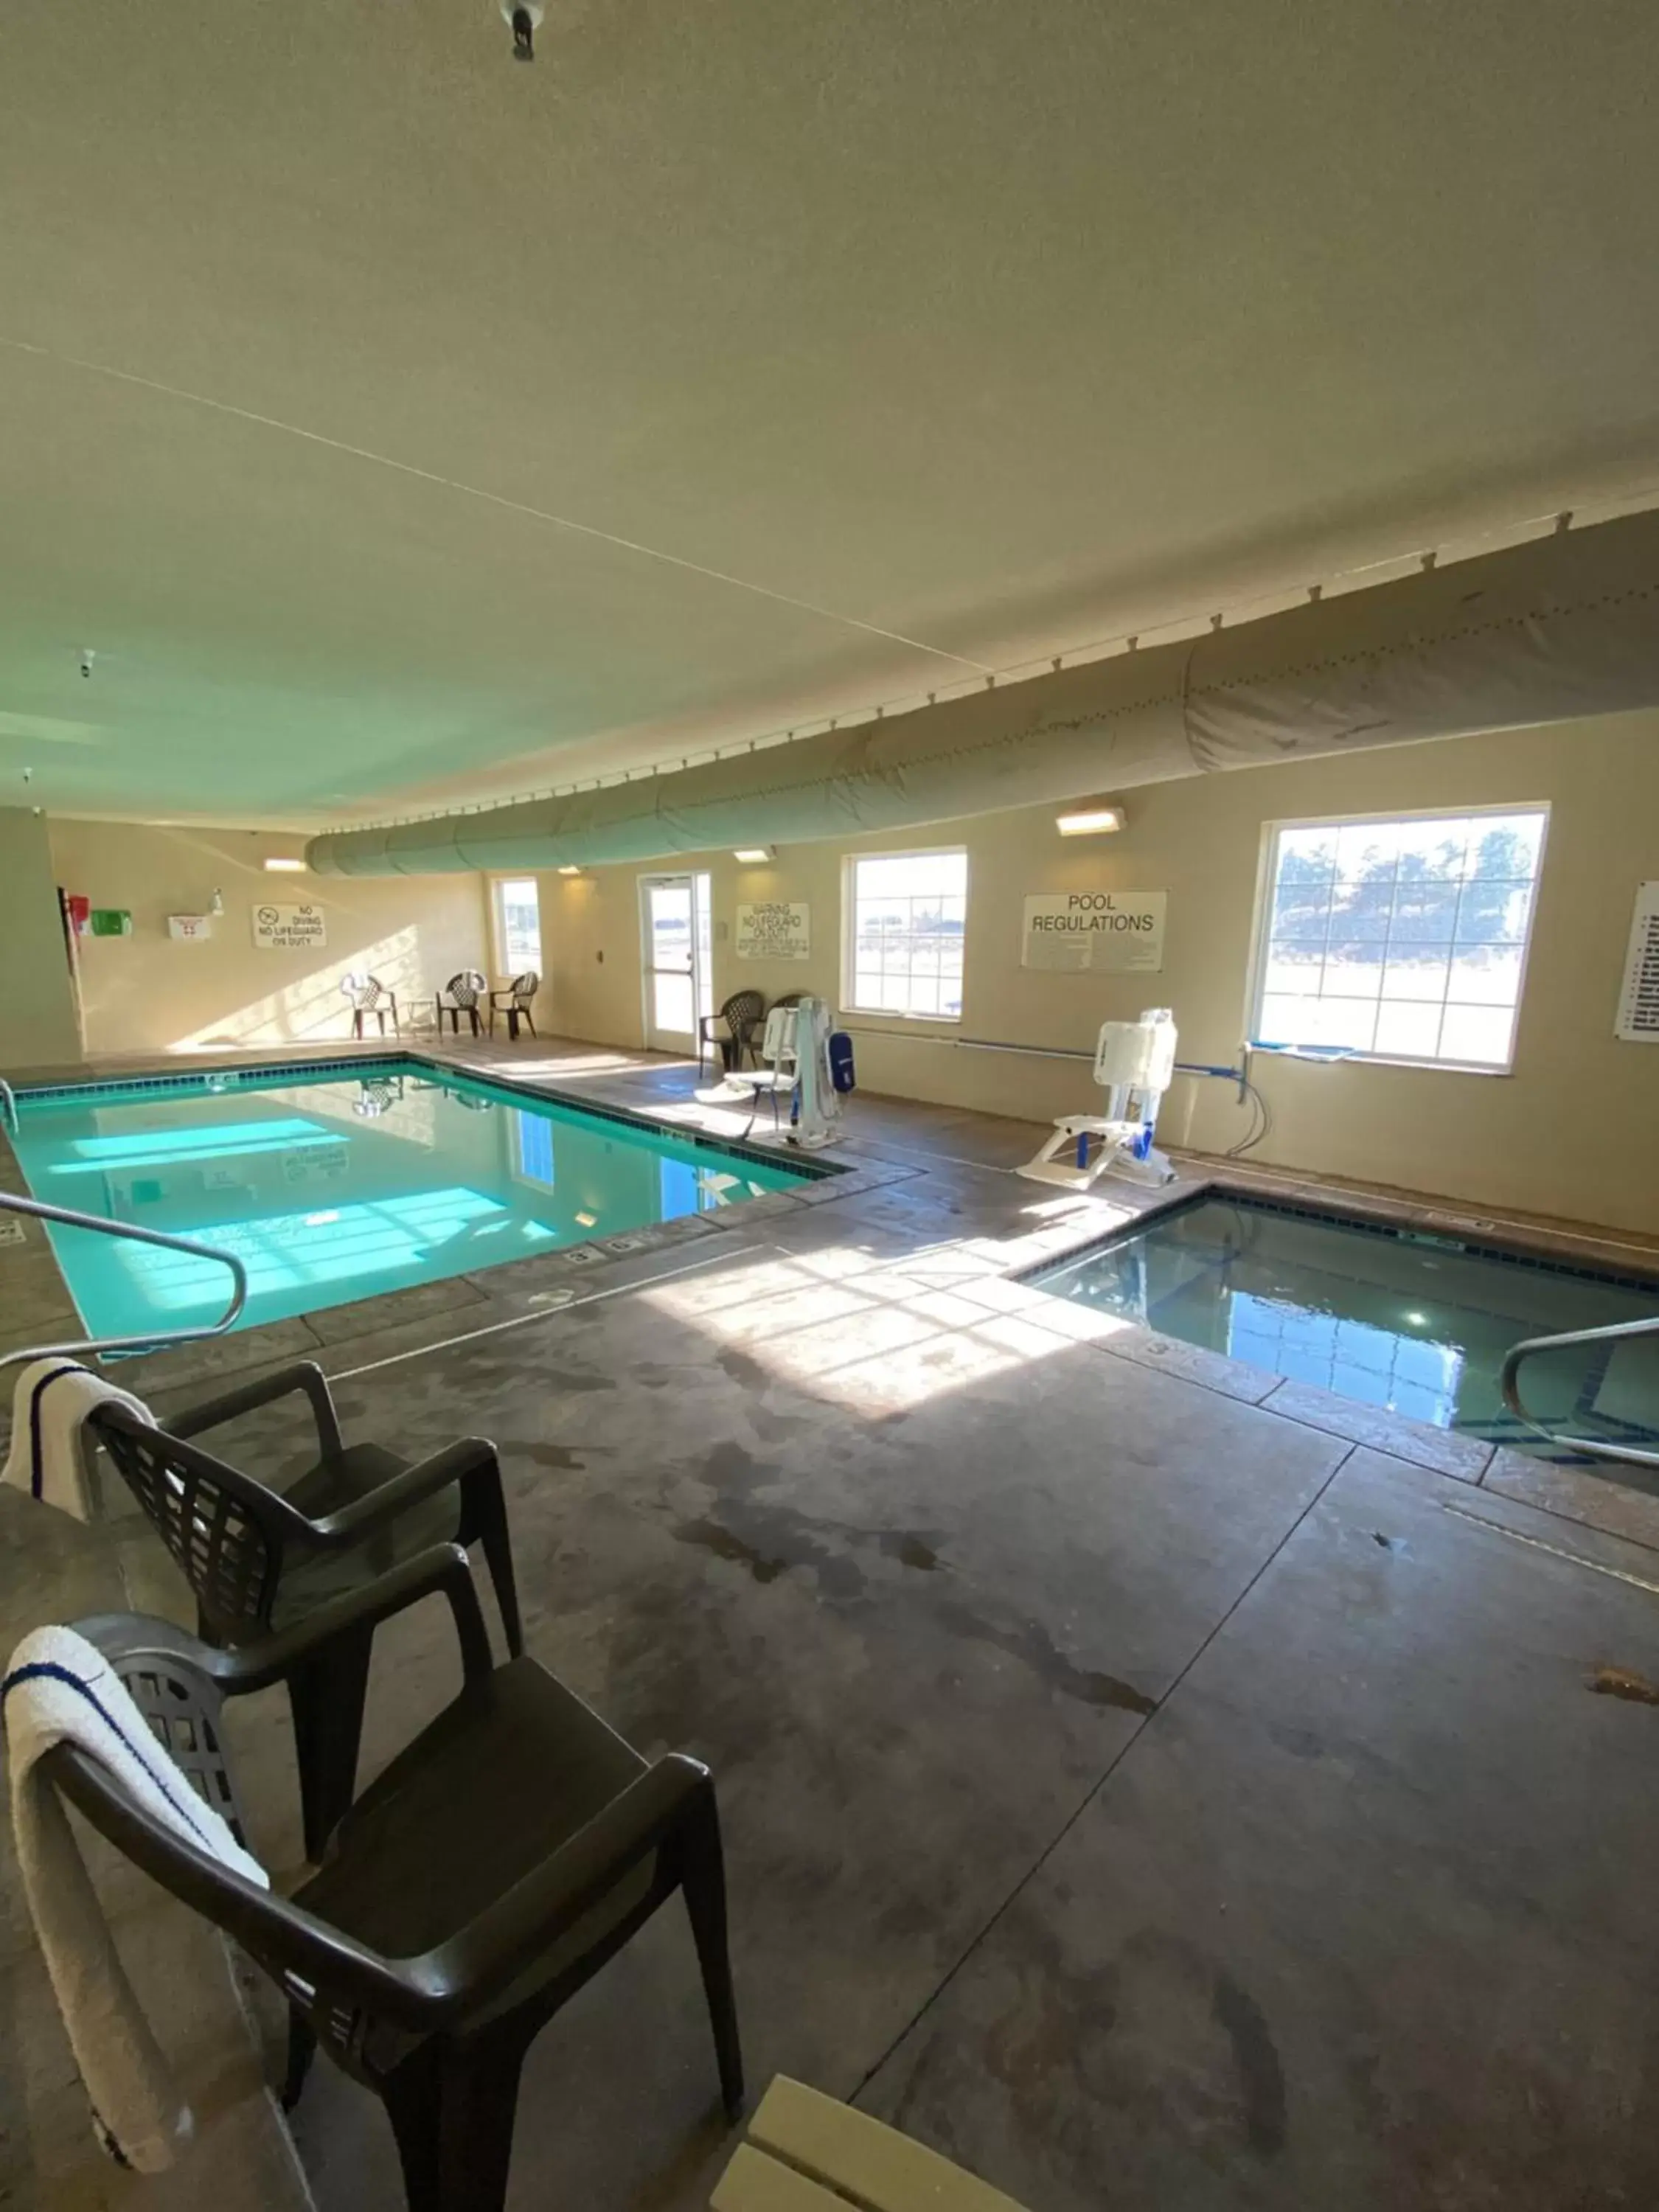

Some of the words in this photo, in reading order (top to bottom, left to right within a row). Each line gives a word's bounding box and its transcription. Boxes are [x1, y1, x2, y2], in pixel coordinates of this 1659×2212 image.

[1068, 894, 1116, 911] POOL
[299, 905, 313, 916] NO
[292, 915, 321, 926] DIVING
[1032, 914, 1155, 932] REGULATIONS
[259, 926, 273, 936] NO
[274, 926, 323, 936] LIFEGUARD
[272, 937, 286, 947] ON
[288, 937, 311, 947] DUTY
